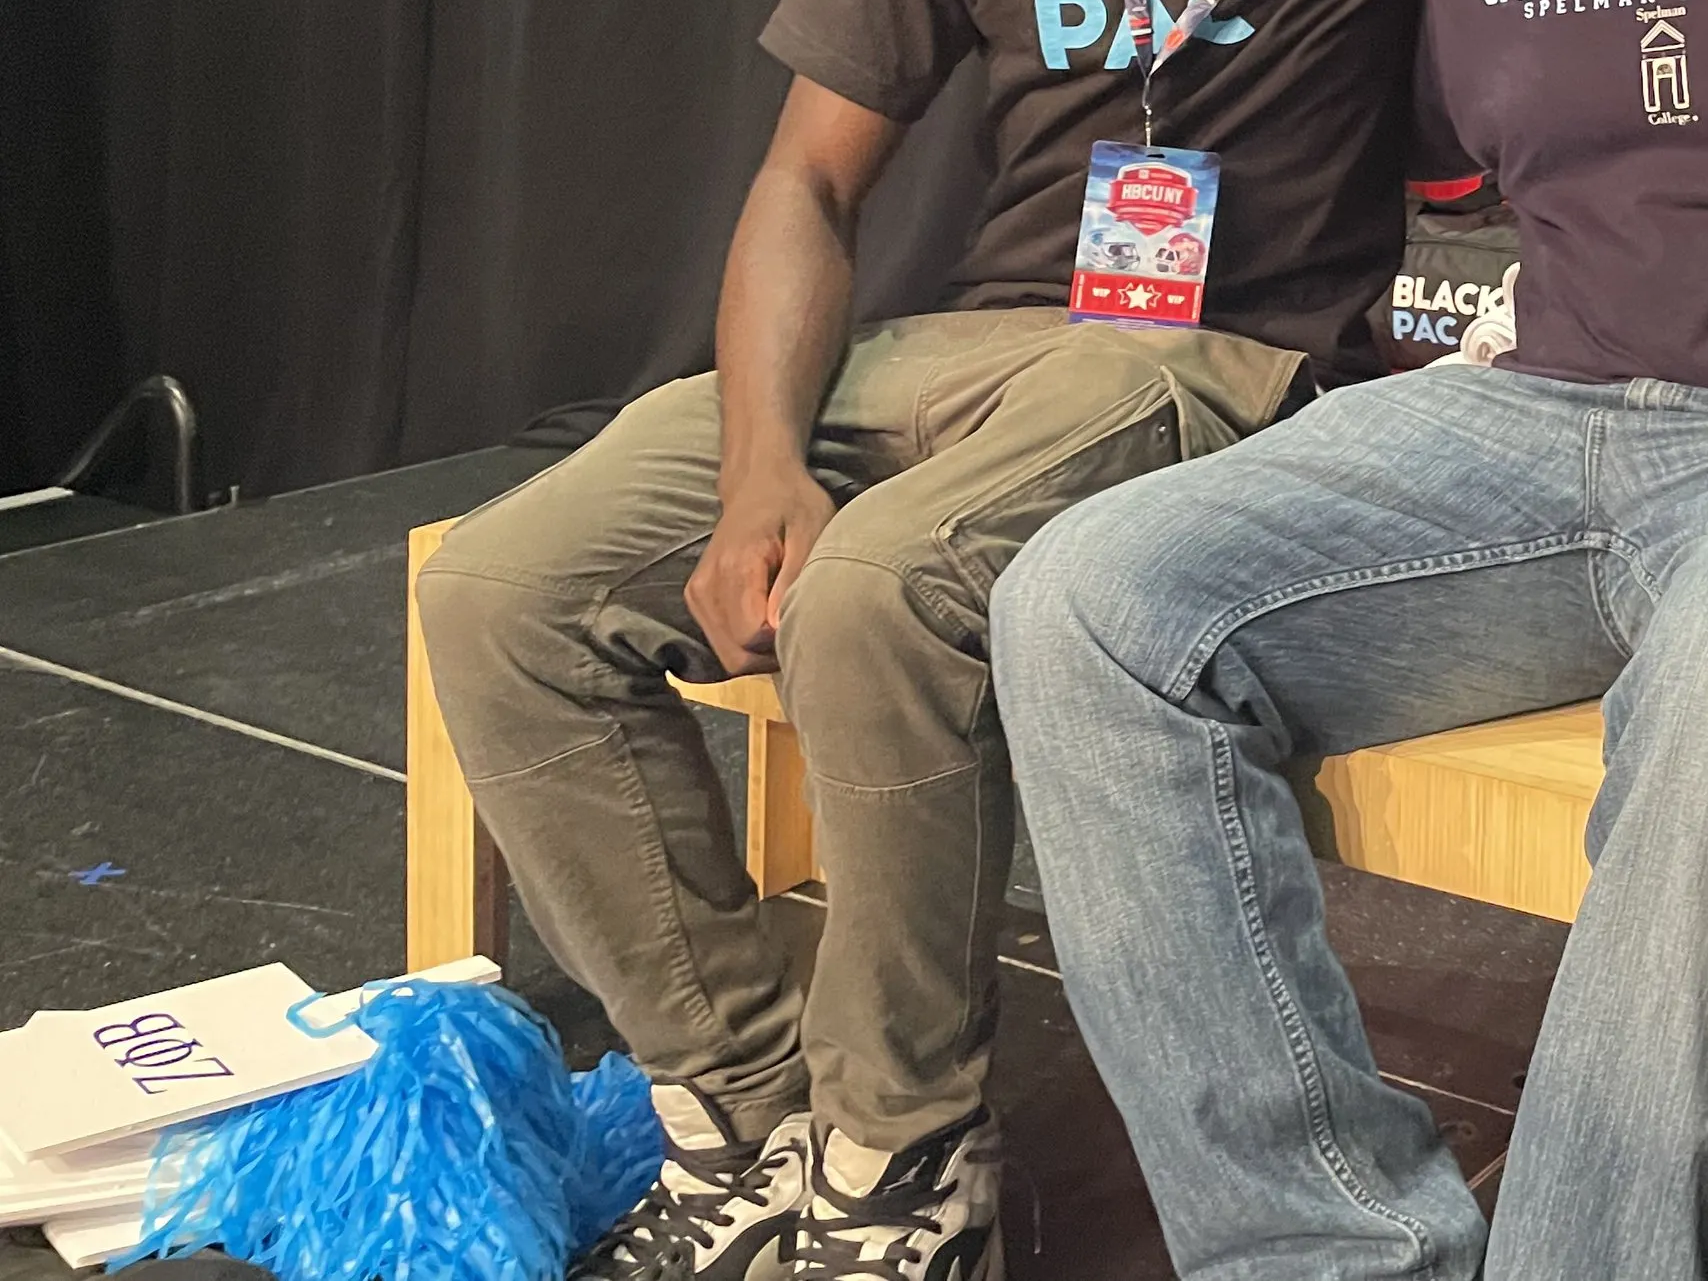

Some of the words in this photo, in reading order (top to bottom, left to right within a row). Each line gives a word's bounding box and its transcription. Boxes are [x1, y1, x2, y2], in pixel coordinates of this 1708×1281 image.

[1636, 5, 1687, 23] Spelman
[1391, 274, 1504, 318] BLACK
[1391, 310, 1459, 346] PAC
